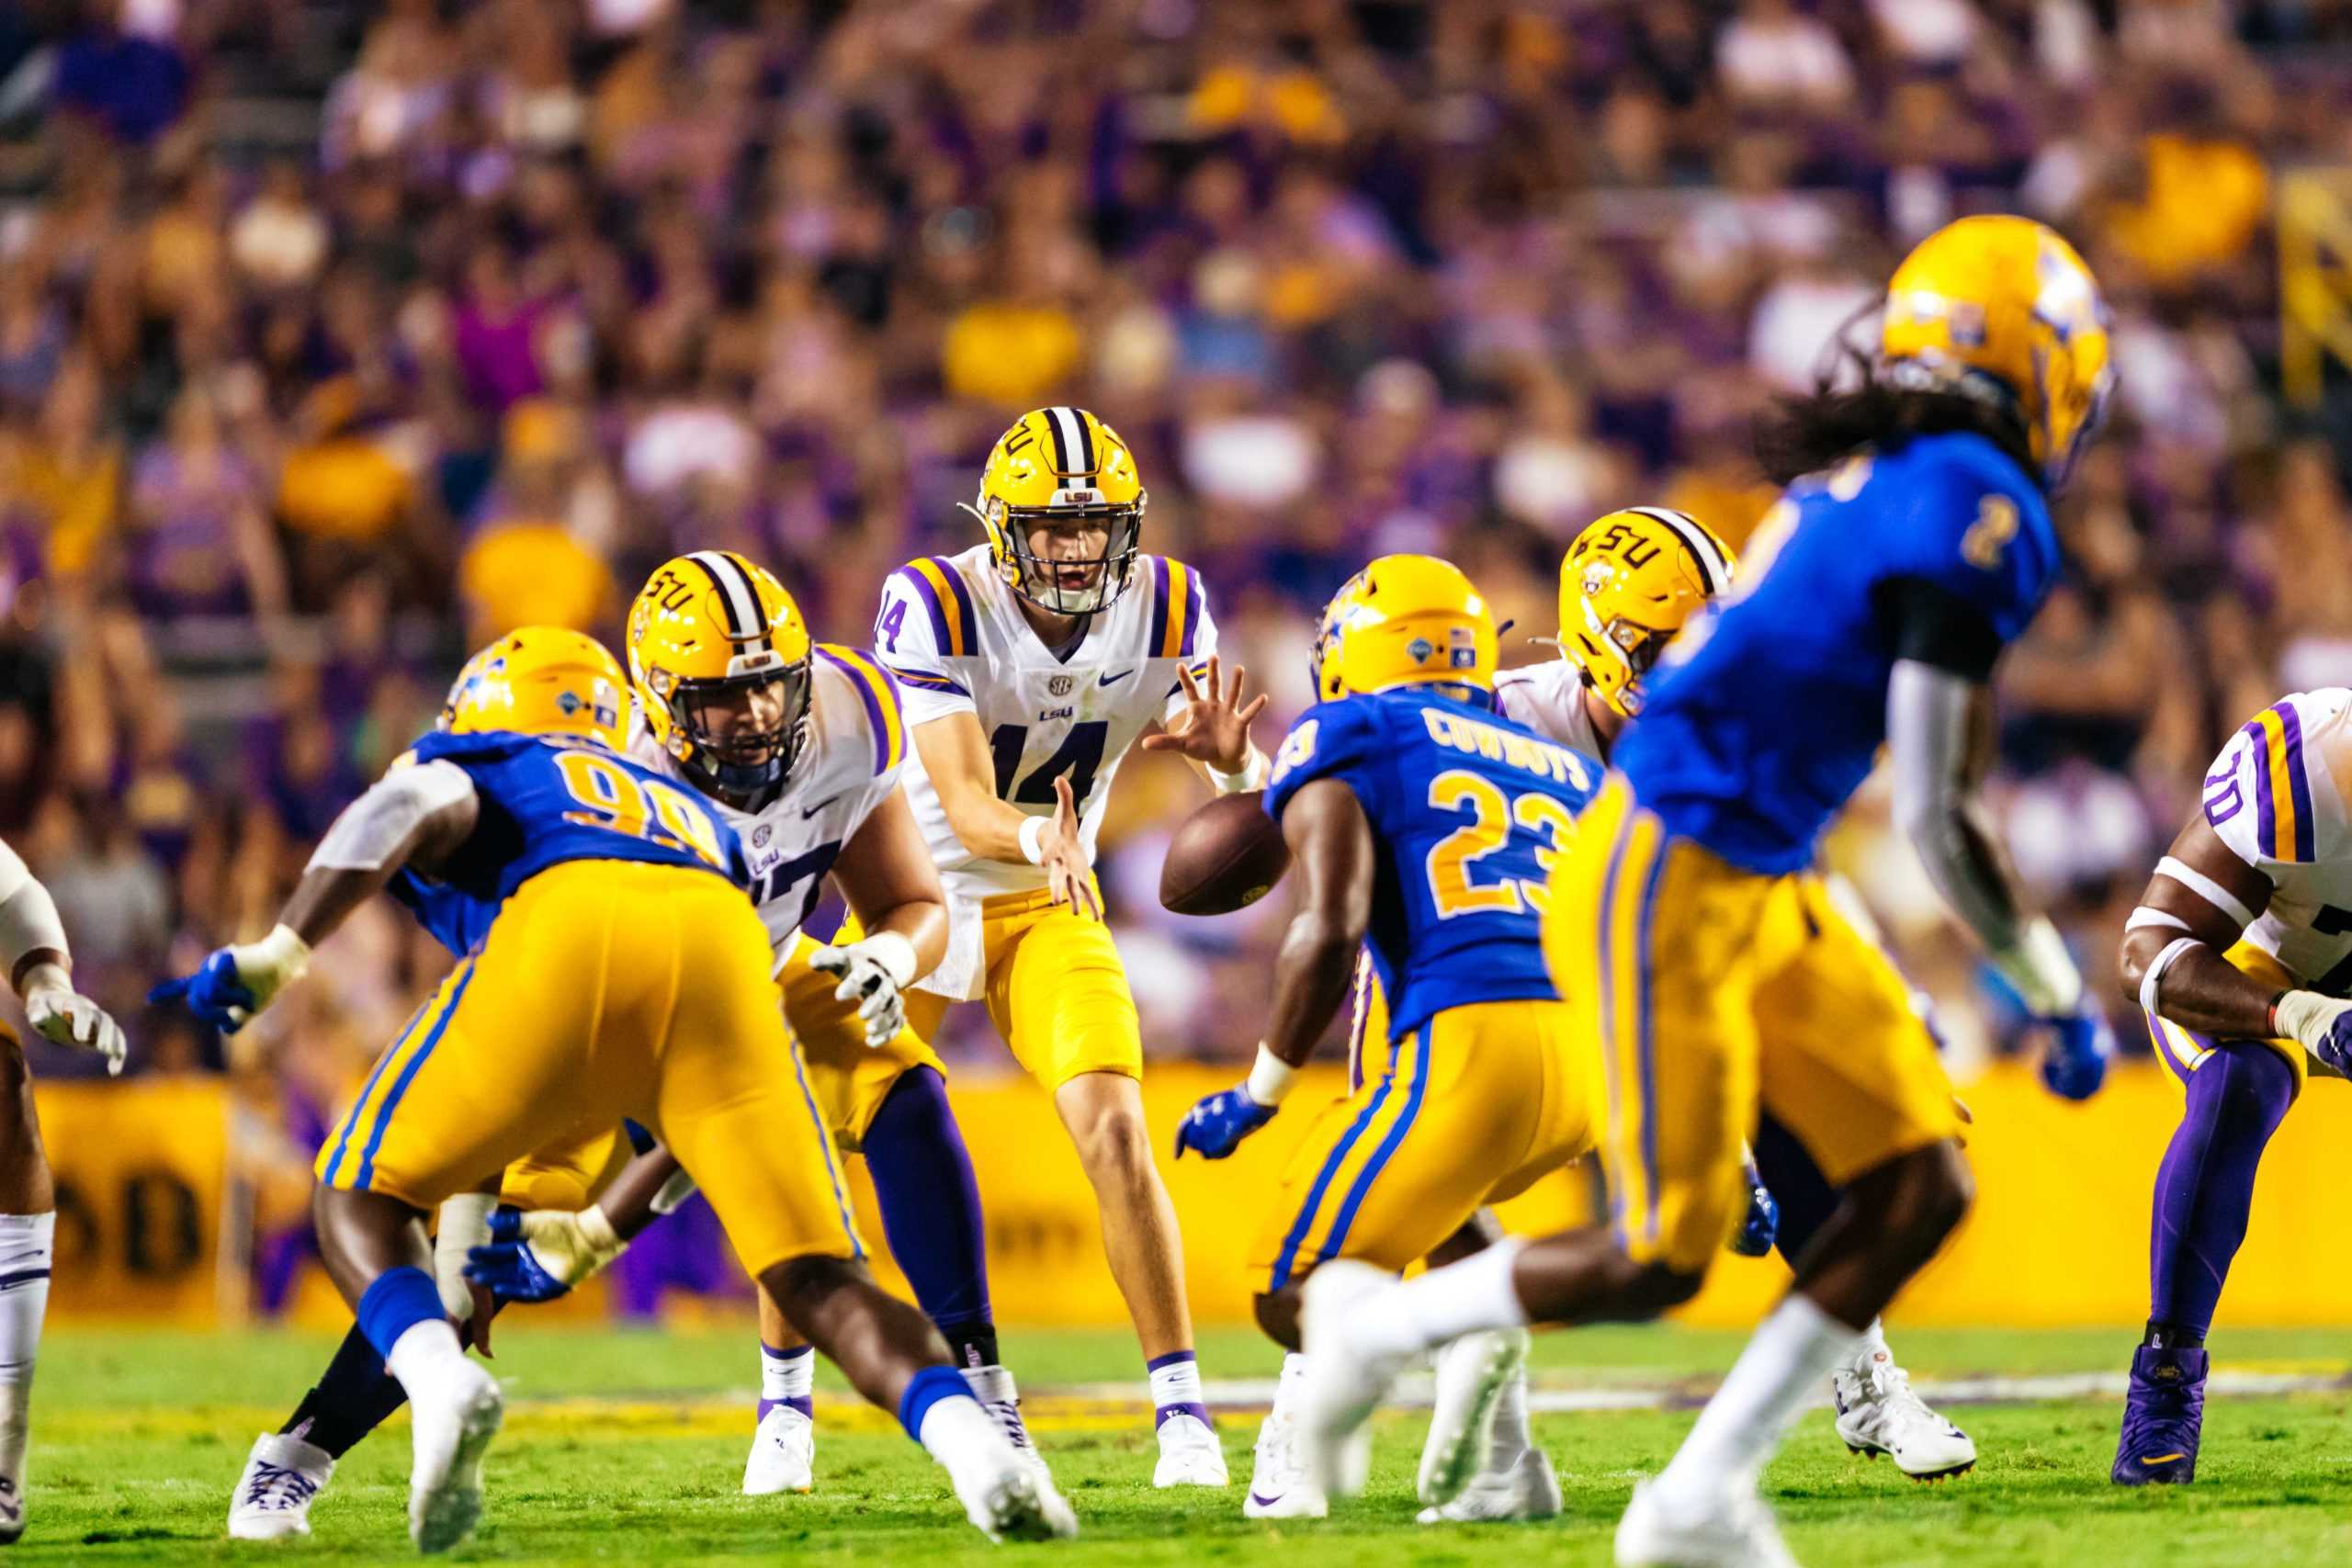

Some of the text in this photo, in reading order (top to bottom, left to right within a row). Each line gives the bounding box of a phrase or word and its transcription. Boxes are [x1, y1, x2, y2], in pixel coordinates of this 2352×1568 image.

[1064, 491, 1093, 503] LSU
[646, 570, 695, 614] SU
[1039, 705, 1074, 722] LSU
[1419, 706, 1591, 793] COWBOYS
[990, 720, 1109, 825] 14
[2203, 750, 2244, 828] 70
[751, 838, 842, 925] 7
[752, 847, 781, 875] LSU
[1425, 768, 1580, 921] 23
